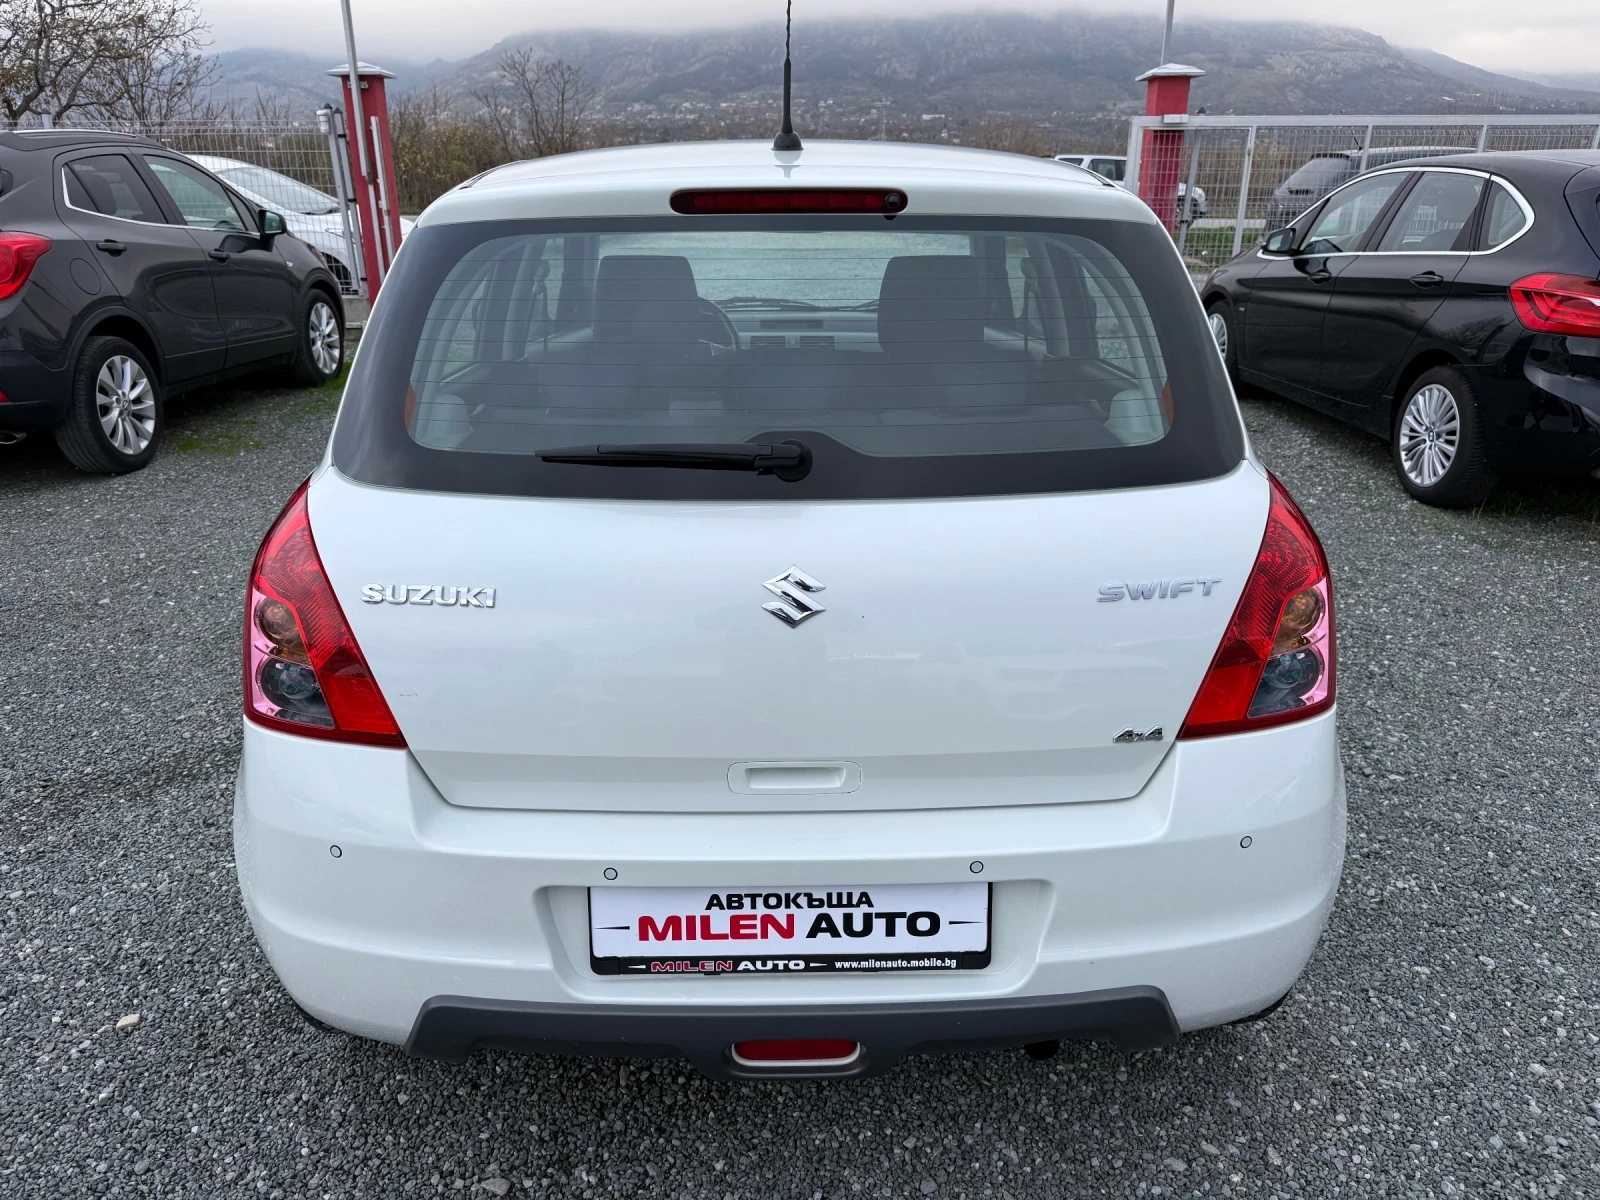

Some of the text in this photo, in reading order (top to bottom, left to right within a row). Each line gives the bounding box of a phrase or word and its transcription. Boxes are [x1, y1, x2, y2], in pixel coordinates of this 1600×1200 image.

[361, 583, 496, 608] SUZUKI
[1097, 577, 1221, 602] SWIFT
[638, 911, 941, 941] MILEN AUTO
[650, 957, 958, 972] MILEN AUTO www.milenauto.mobile.bg
